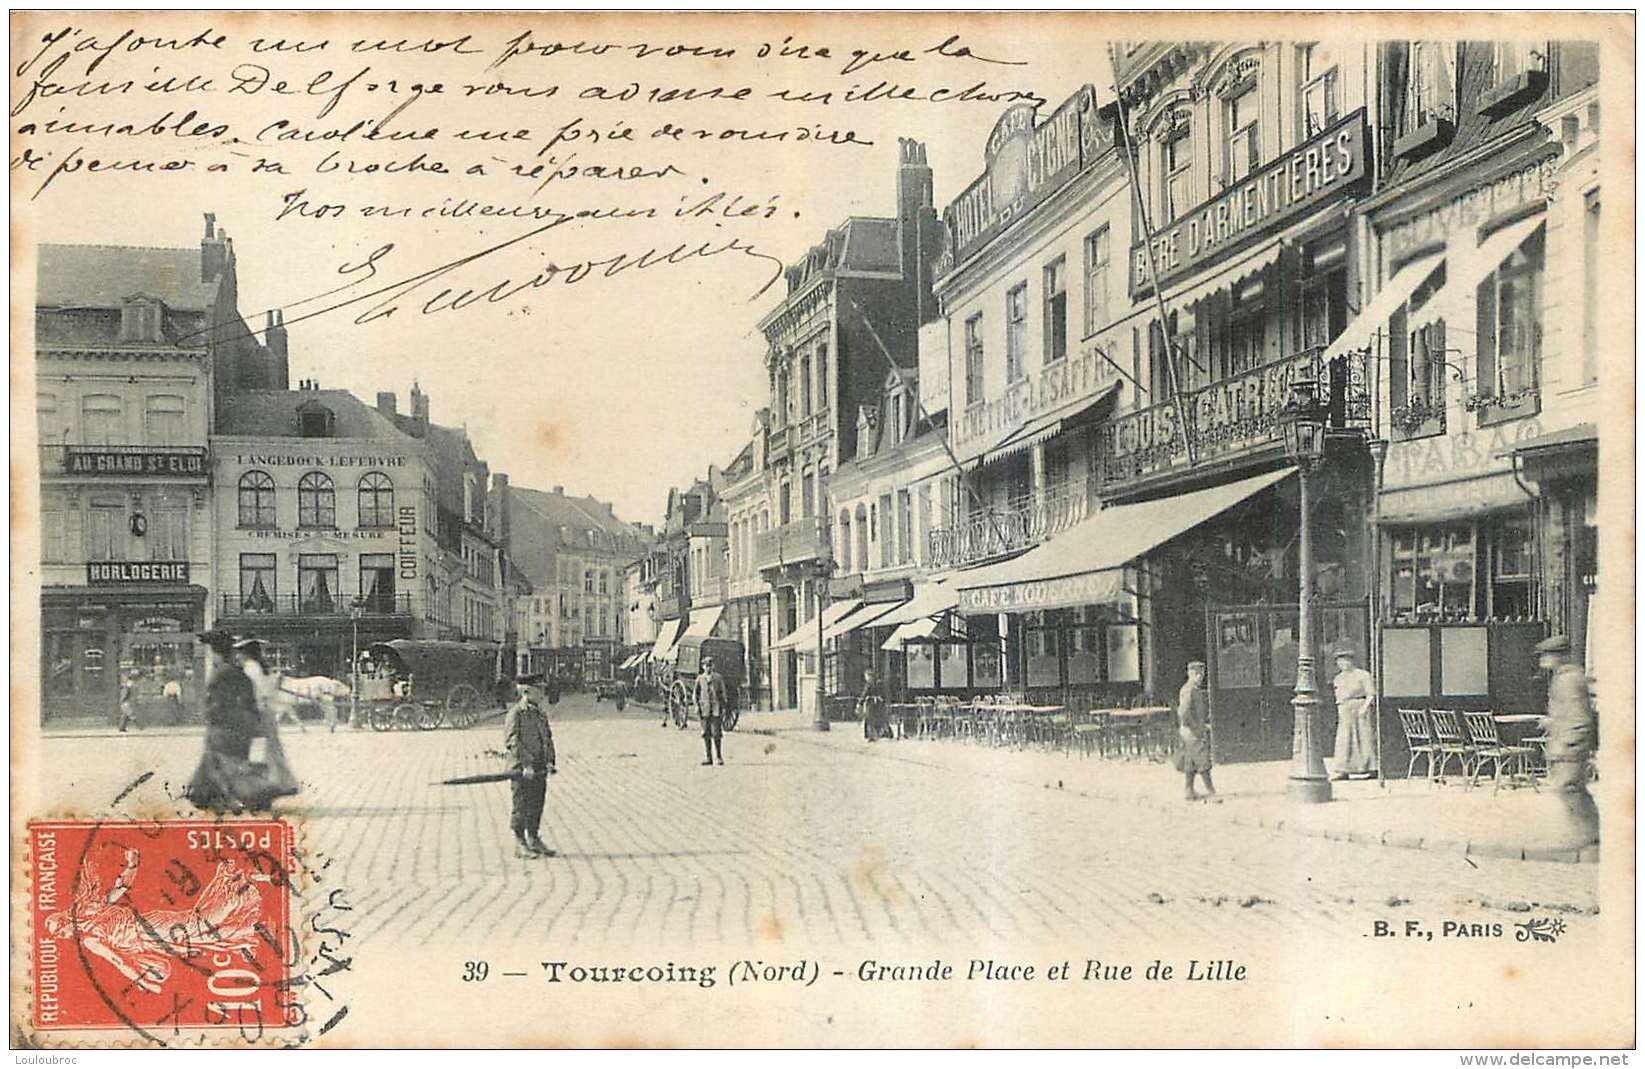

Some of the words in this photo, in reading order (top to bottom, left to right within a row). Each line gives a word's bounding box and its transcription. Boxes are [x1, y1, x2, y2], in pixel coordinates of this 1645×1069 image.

[352, 35, 483, 54] mot
[484, 29, 622, 73] pour
[628, 42, 736, 58] vous
[757, 36, 832, 59] dire
[840, 48, 915, 75] que
[924, 34, 1028, 65] la
[464, 82, 560, 98] vous
[453, 128, 531, 141] me
[537, 118, 634, 157] prie
[316, 151, 449, 175] broche
[999, 195, 1026, 225] DU
[1026, 103, 1079, 192] CYGNE
[1115, 404, 1176, 458] LOUIS
[73, 455, 91, 471] AU
[97, 455, 142, 471] GRAND
[169, 456, 201, 472] ELOI
[399, 506, 417, 580] COIFFEUR
[90, 564, 187, 580] HORLOGERIE
[188, 829, 271, 850] POSTES
